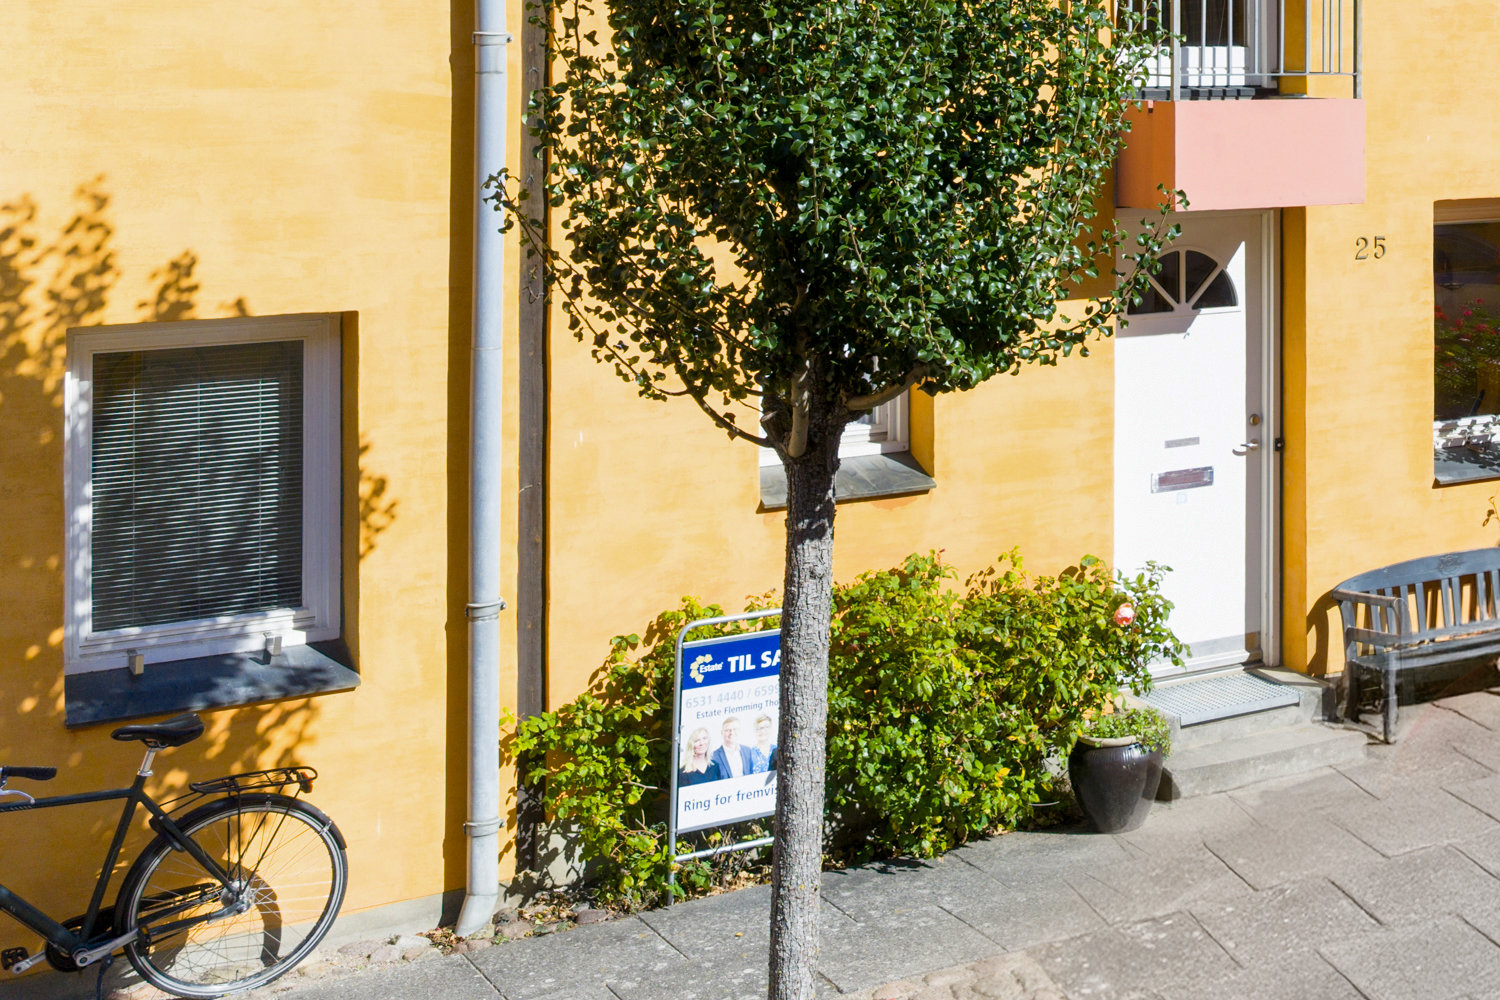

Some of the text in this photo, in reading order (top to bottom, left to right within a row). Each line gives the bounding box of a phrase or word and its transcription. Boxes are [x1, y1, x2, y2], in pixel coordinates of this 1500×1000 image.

[1355, 235, 1386, 260] 25
[699, 662, 723, 673] Estate
[727, 653, 756, 673] TIL
[685, 695, 712, 709] 6531
[717, 689, 744, 703] 4440
[696, 708, 721, 719] Estate
[724, 701, 763, 715] Flemming
[684, 799, 711, 811] Ring
[715, 794, 733, 806] for
